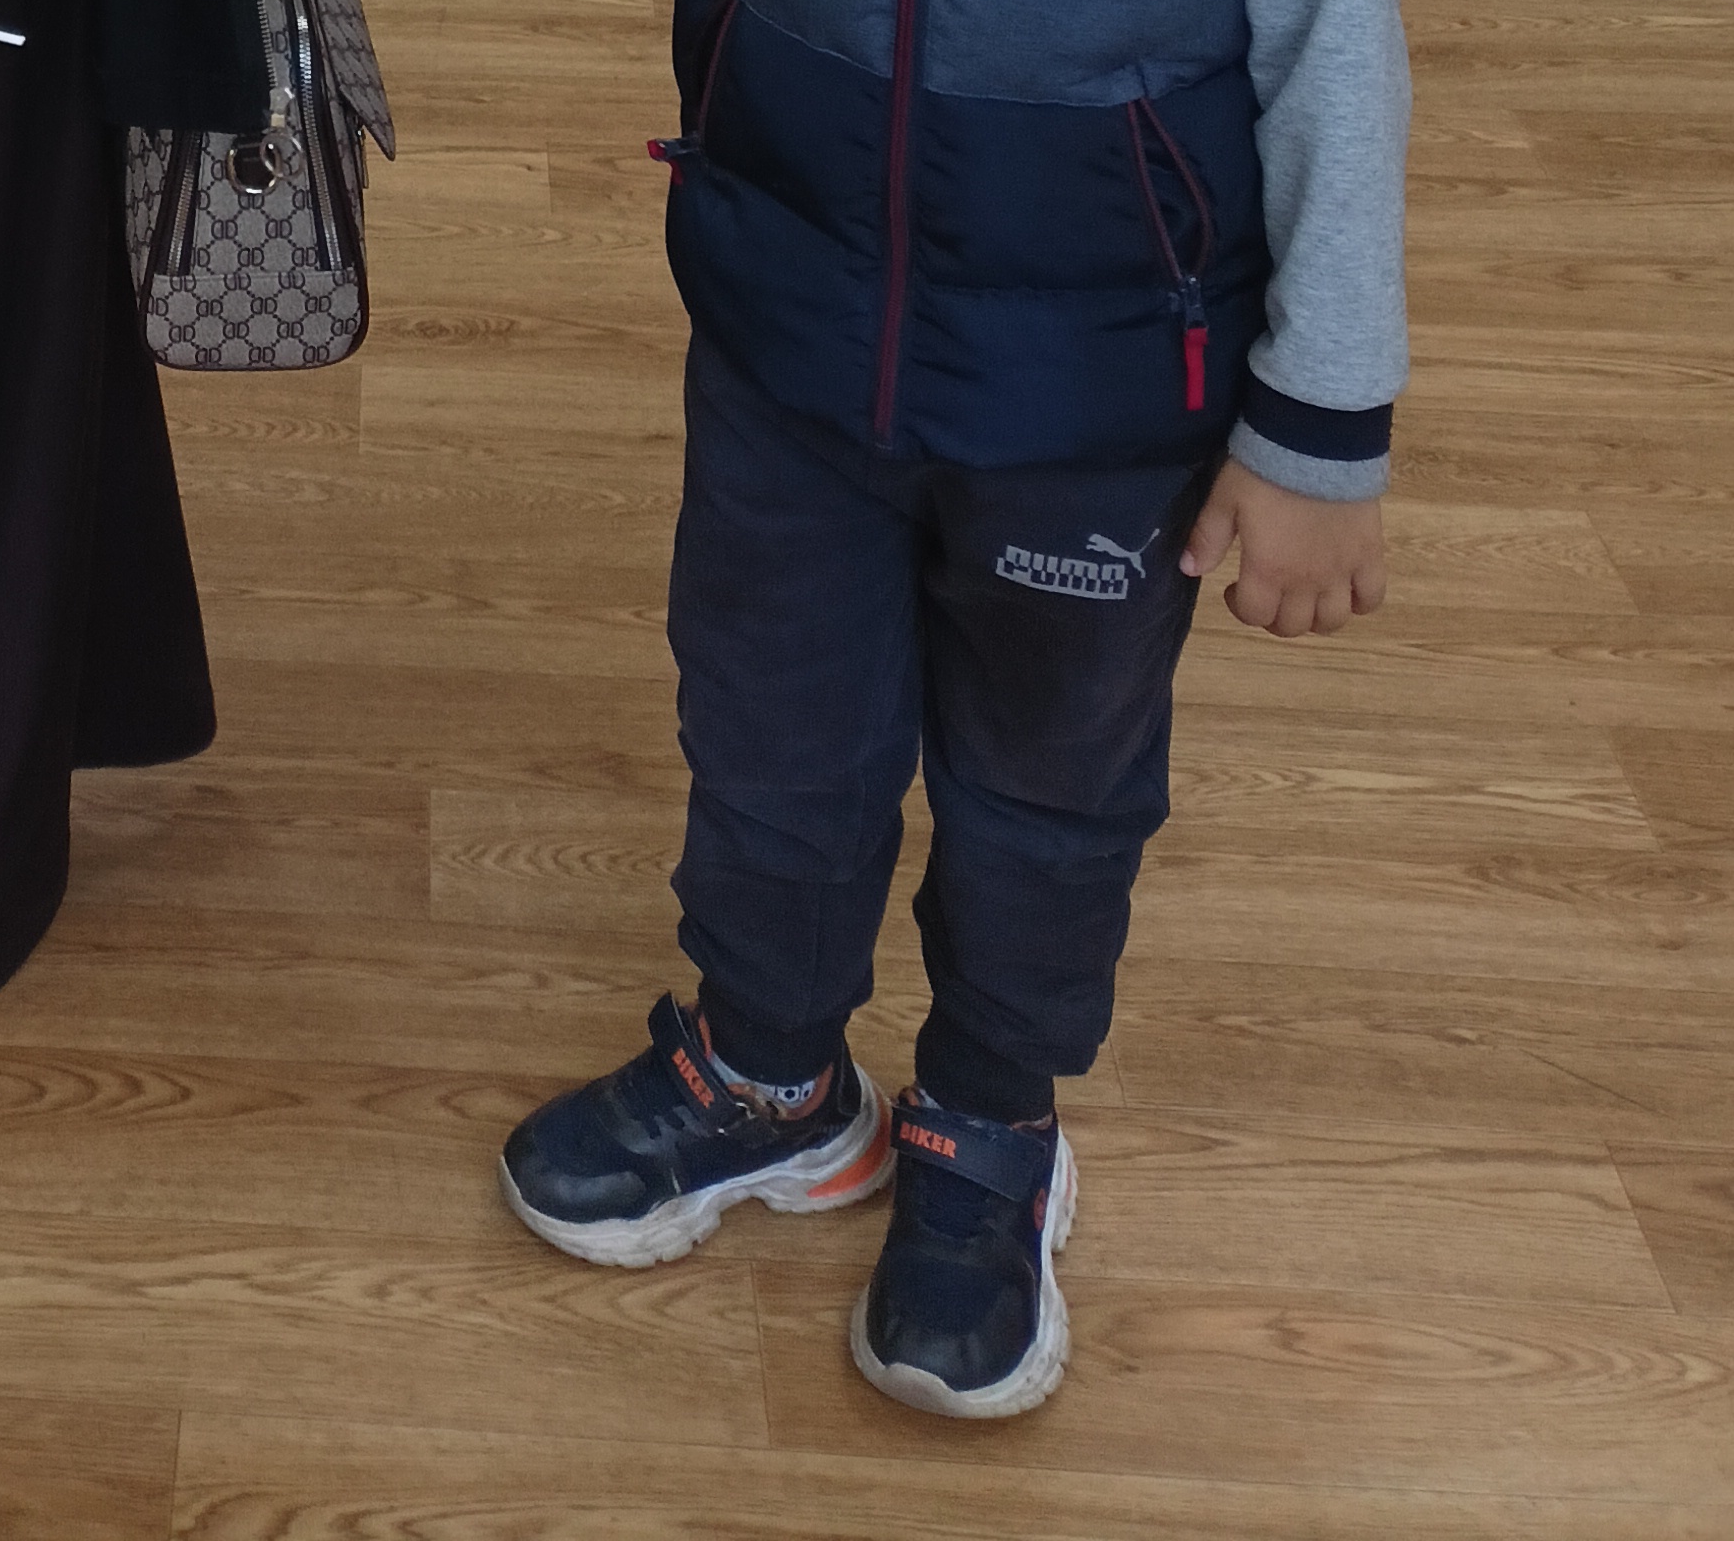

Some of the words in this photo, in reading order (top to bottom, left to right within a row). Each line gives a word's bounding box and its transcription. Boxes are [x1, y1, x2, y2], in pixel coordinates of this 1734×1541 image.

[1003, 545, 1127, 595] PUMA
[672, 1048, 716, 1109] BIKER
[900, 1121, 957, 1159] BIKER
